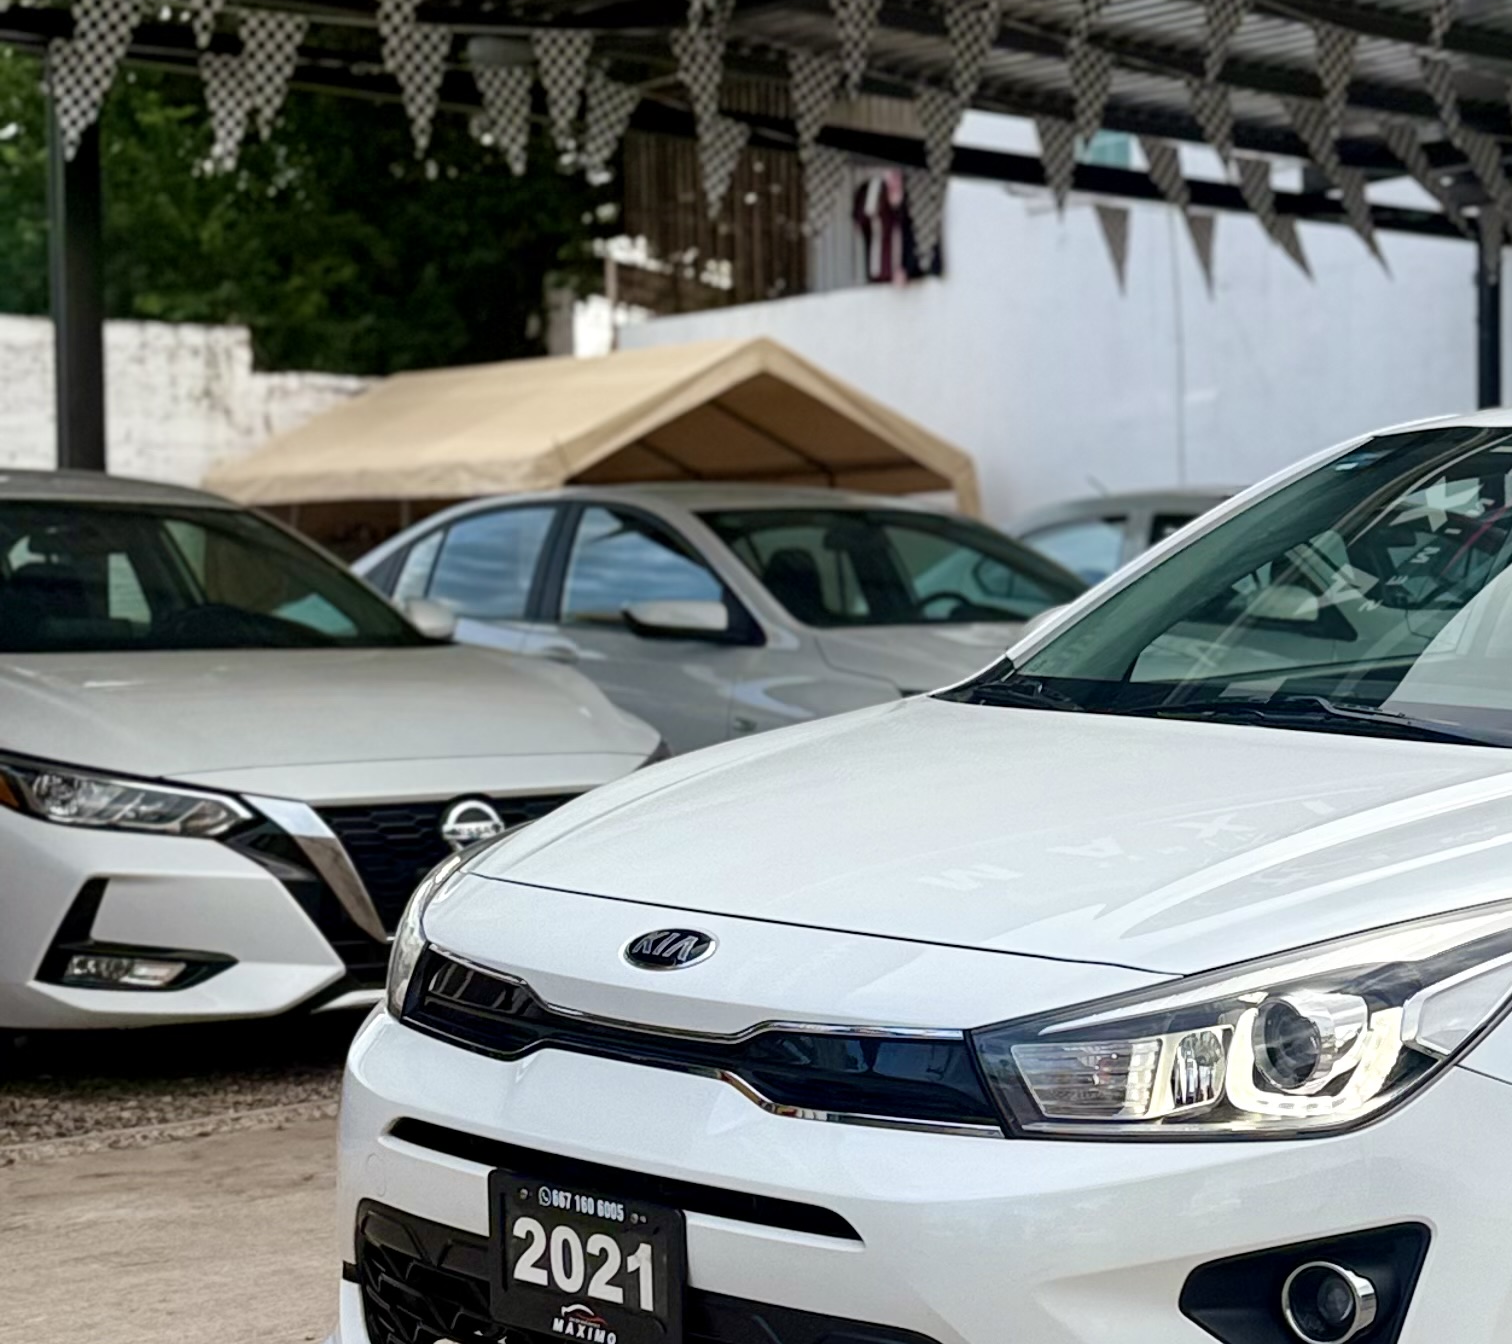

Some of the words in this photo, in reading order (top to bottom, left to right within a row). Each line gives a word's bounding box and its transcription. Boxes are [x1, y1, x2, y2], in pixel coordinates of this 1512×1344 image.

[632, 930, 699, 962] KIA
[552, 1189, 572, 1210] 667
[574, 1194, 595, 1215] 160
[597, 1199, 624, 1222] 6005
[512, 1216, 654, 1313] 2021
